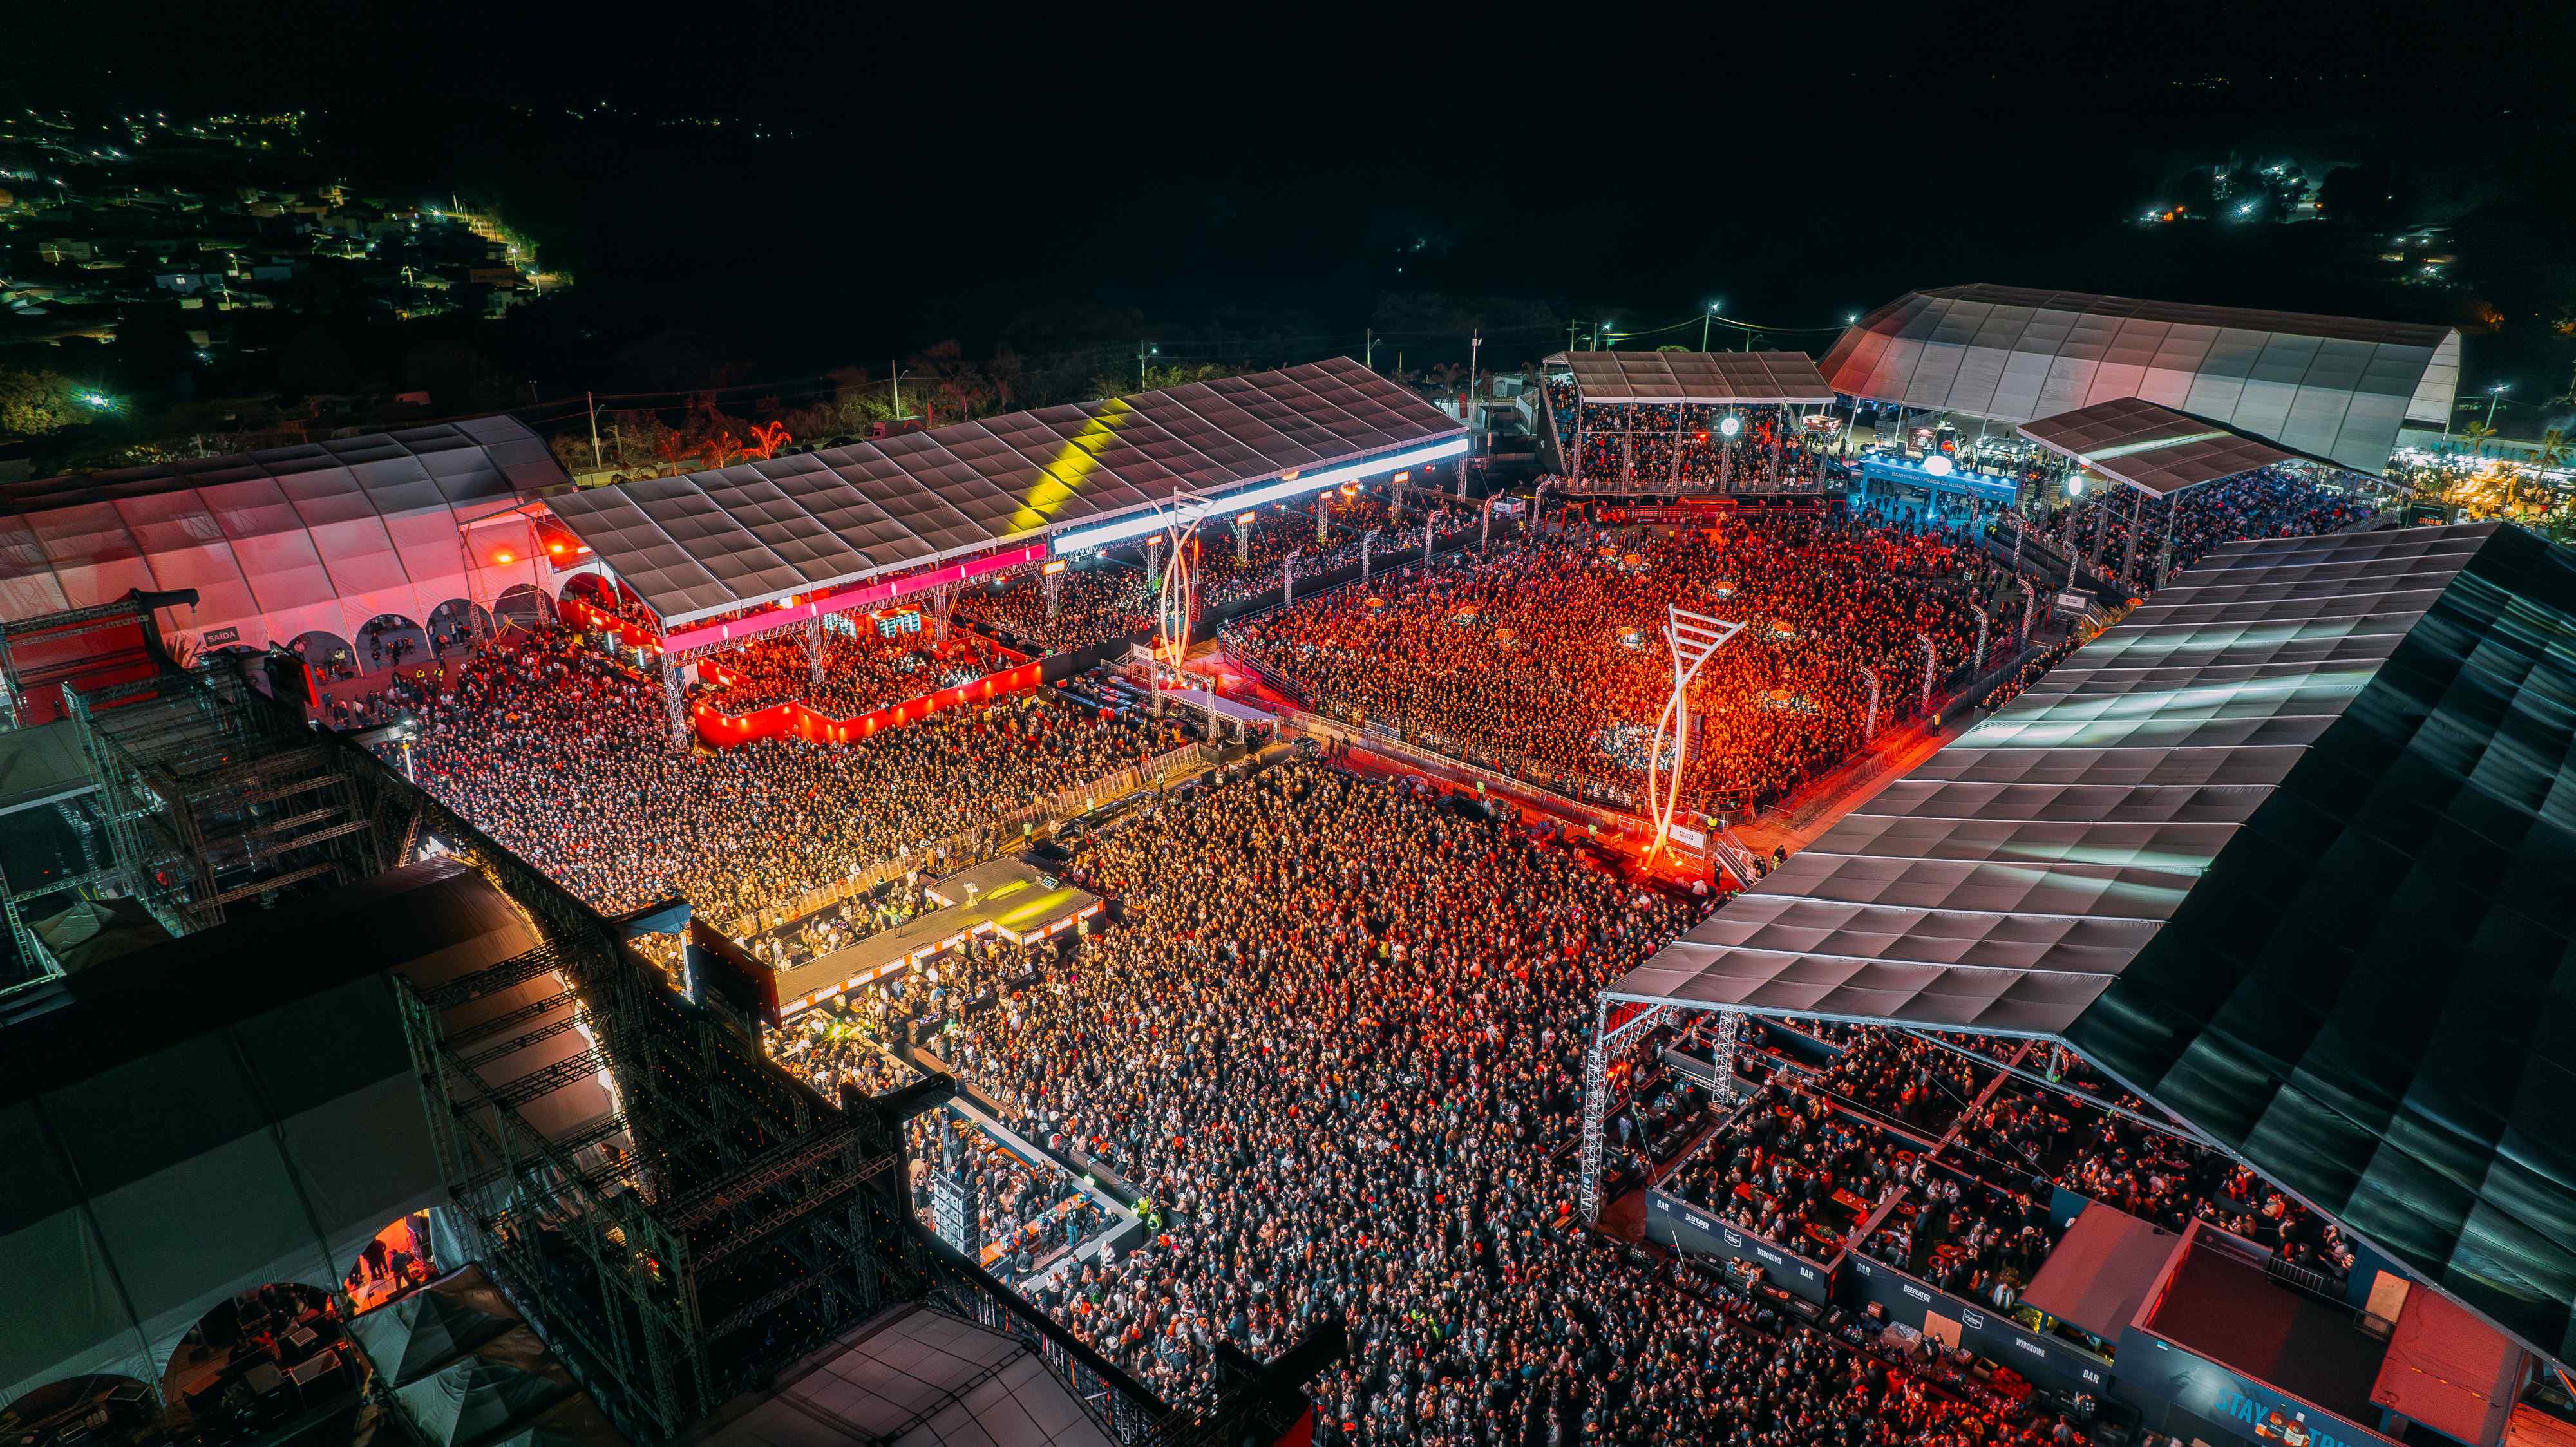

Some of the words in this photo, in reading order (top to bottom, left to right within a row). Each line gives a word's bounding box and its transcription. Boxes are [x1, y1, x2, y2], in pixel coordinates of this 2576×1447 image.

[207, 631, 236, 643] SAÍDA
[1657, 1199, 1669, 1212] BAR
[1685, 1213, 1709, 1230] BEEFEATER
[1757, 1247, 1781, 1265] WYBOROWA
[1800, 1267, 1814, 1280] BAR
[1857, 1263, 1871, 1276] BAR
[1903, 1284, 1931, 1303] BEEFEATER
[2016, 1337, 2045, 1358] WYBOROWA
[2083, 1369, 2099, 1384] BAR
[2215, 1386, 2269, 1426] STAY
